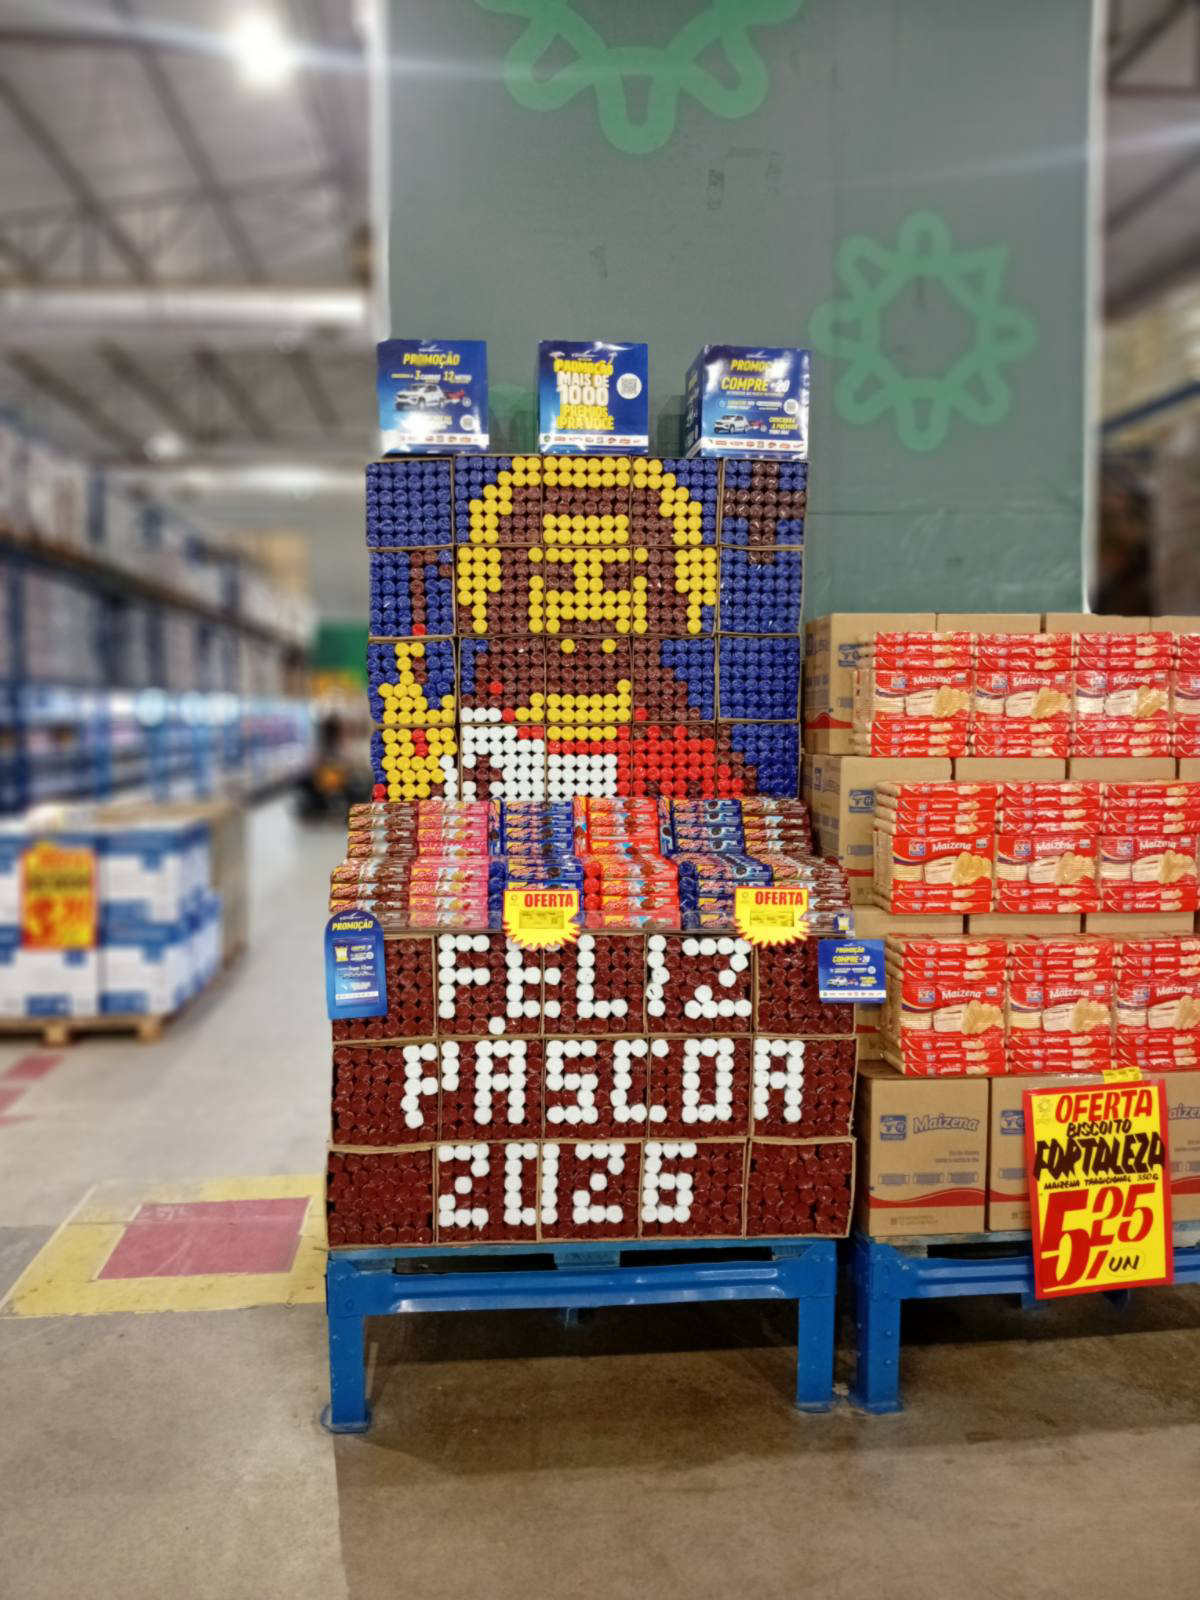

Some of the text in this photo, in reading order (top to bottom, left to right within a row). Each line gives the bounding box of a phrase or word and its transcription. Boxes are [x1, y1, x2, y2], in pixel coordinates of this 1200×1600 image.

[403, 351, 461, 368] PROMOÇÃO
[557, 371, 609, 387] MAIS DE
[721, 376, 768, 392] COMPRE
[557, 384, 609, 406] 1000
[913, 676, 952, 687] Maizena
[1013, 675, 1051, 688] Maizena
[932, 841, 972, 853] Maizena
[1035, 839, 1076, 853] Maizena
[1139, 839, 1177, 851] Maizena
[524, 893, 574, 907] OFERTA
[755, 891, 804, 905] OFERTA
[332, 919, 374, 931] PROMOÇÃO
[438, 934, 752, 1020] FELIZ
[941, 984, 982, 1000] Maizena
[1050, 984, 1090, 998] Maizena
[1156, 980, 1194, 997] Maizena
[400, 1038, 806, 1130] PASCOA
[1055, 1089, 1153, 1124] OFERTA
[913, 1113, 979, 1134] Maizena
[1066, 1119, 1132, 1137] BISCOITO
[1034, 1131, 1166, 1181] FORTALEZA
[438, 1142, 697, 1230] 2026
[1044, 1180, 1080, 1190] MAIZENA
[1108, 1255, 1140, 1272] UN
